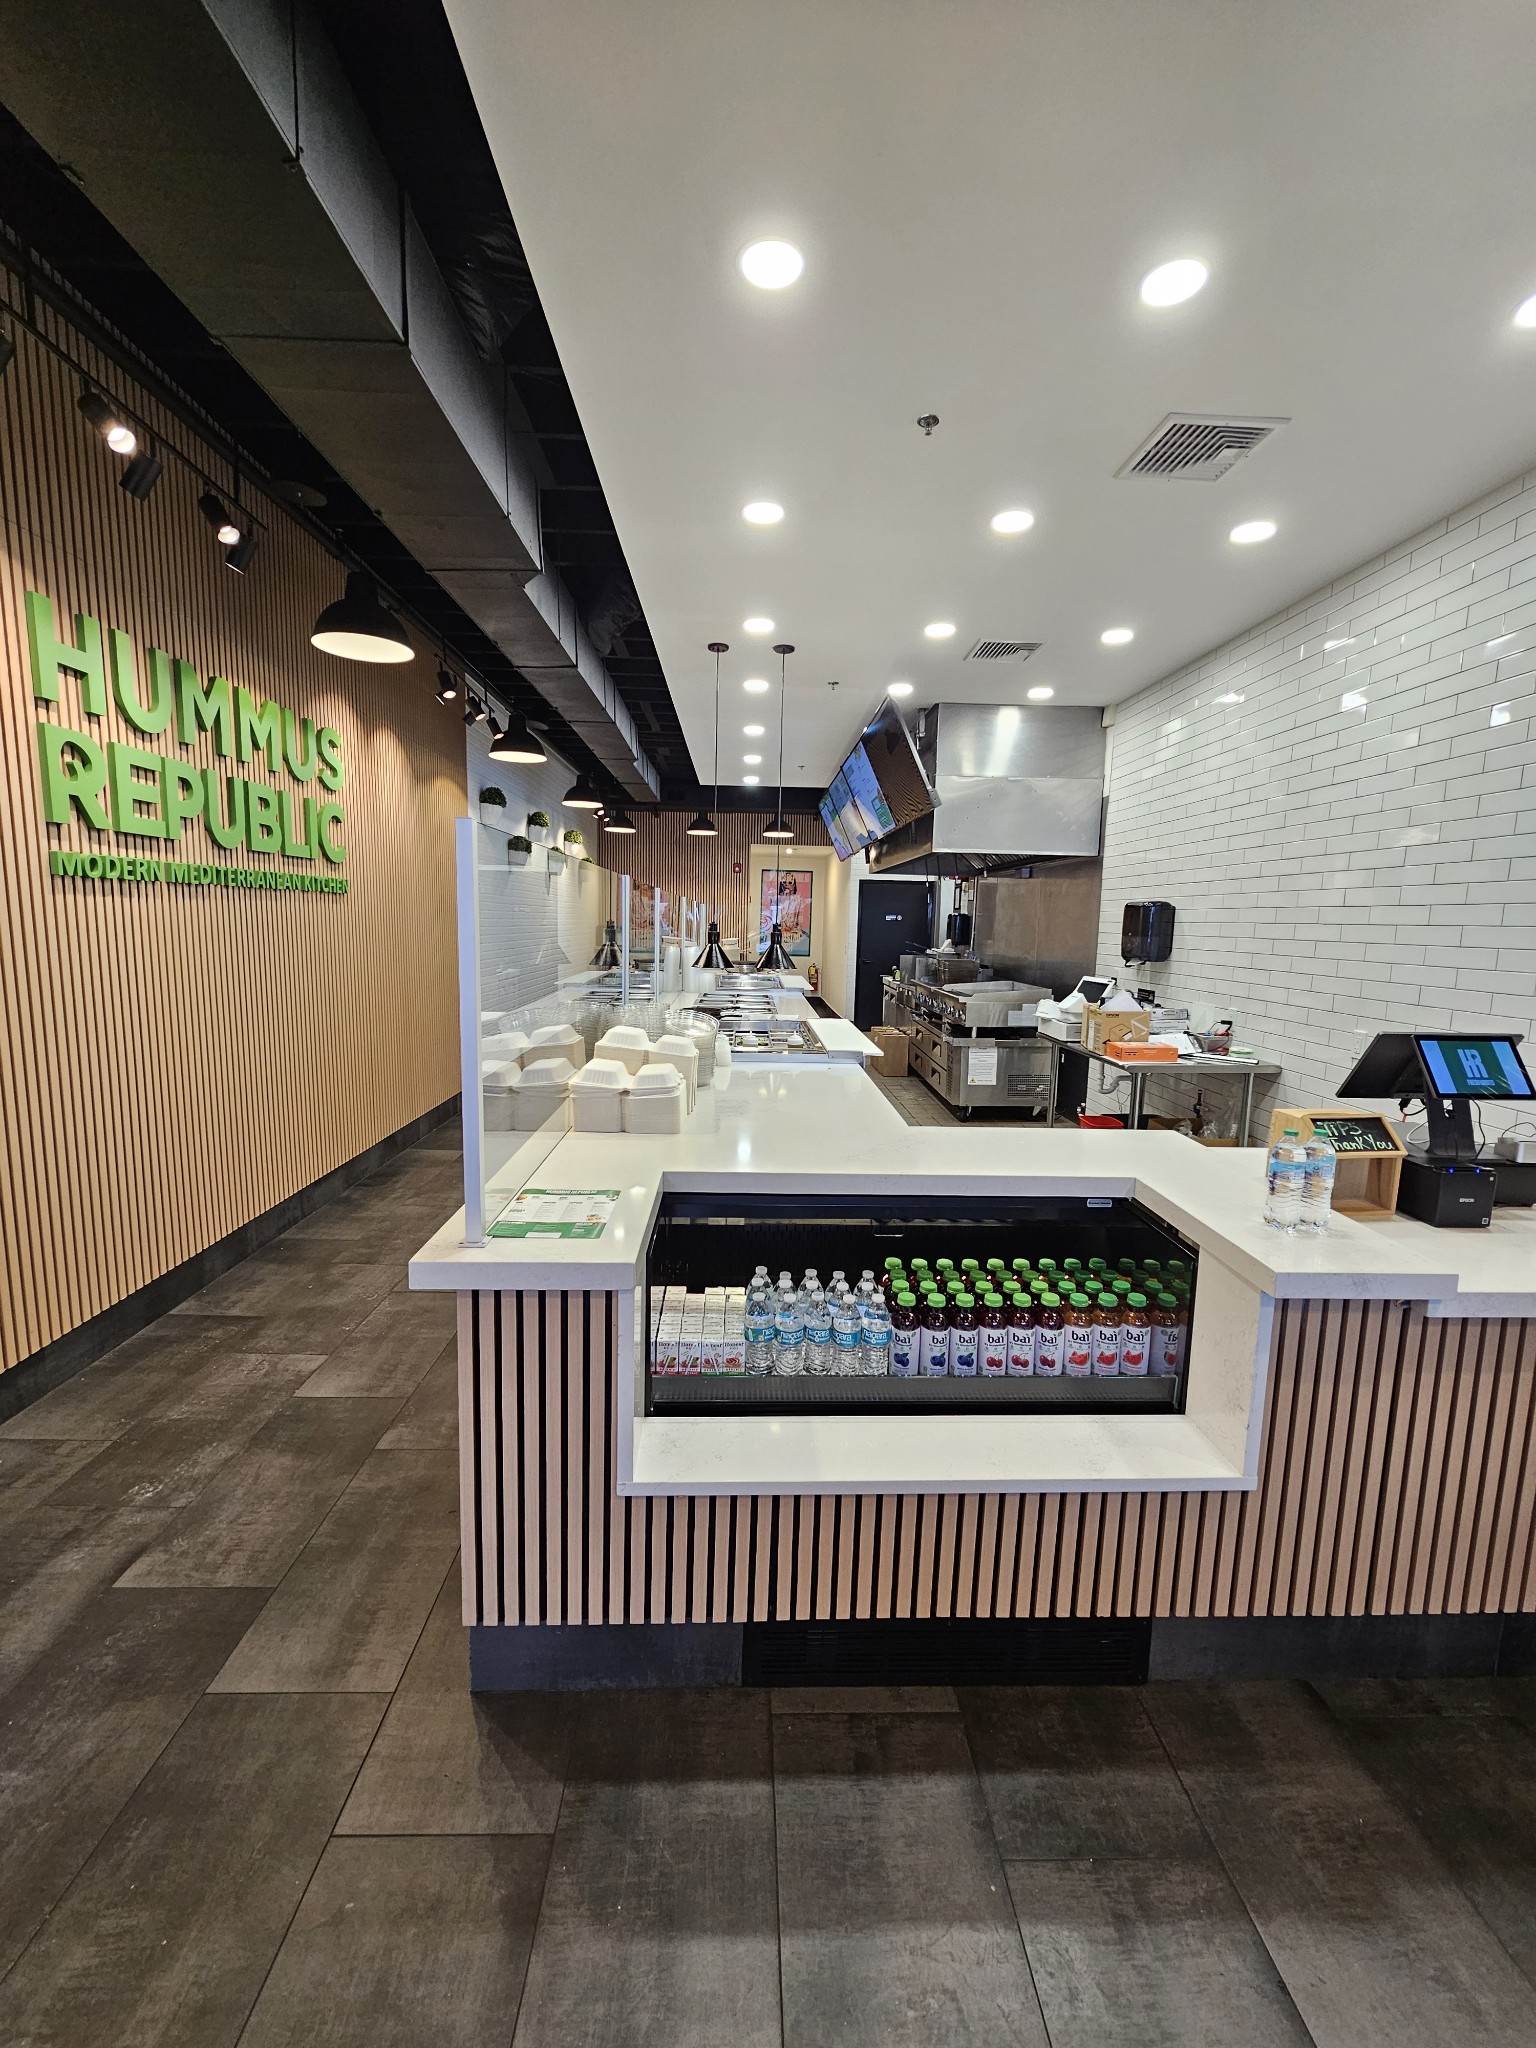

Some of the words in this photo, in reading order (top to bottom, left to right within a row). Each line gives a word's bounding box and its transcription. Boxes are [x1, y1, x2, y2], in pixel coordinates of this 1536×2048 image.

[25, 590, 345, 792] HUMMUS
[37, 721, 348, 864] REPUBLIC
[50, 850, 163, 882] MODERN
[164, 861, 301, 891] MEDITERRANEAN
[301, 873, 349, 894] KITCHEN
[863, 1328, 887, 1343] niagara
[894, 1332, 912, 1345] bai
[958, 1333, 976, 1344] bai
[987, 1333, 1005, 1344] bai
[1012, 1332, 1031, 1344] bai
[1040, 1332, 1057, 1344] bai
[1071, 1330, 1090, 1342] bai
[1099, 1330, 1118, 1342] bai
[1126, 1329, 1145, 1342] bai
